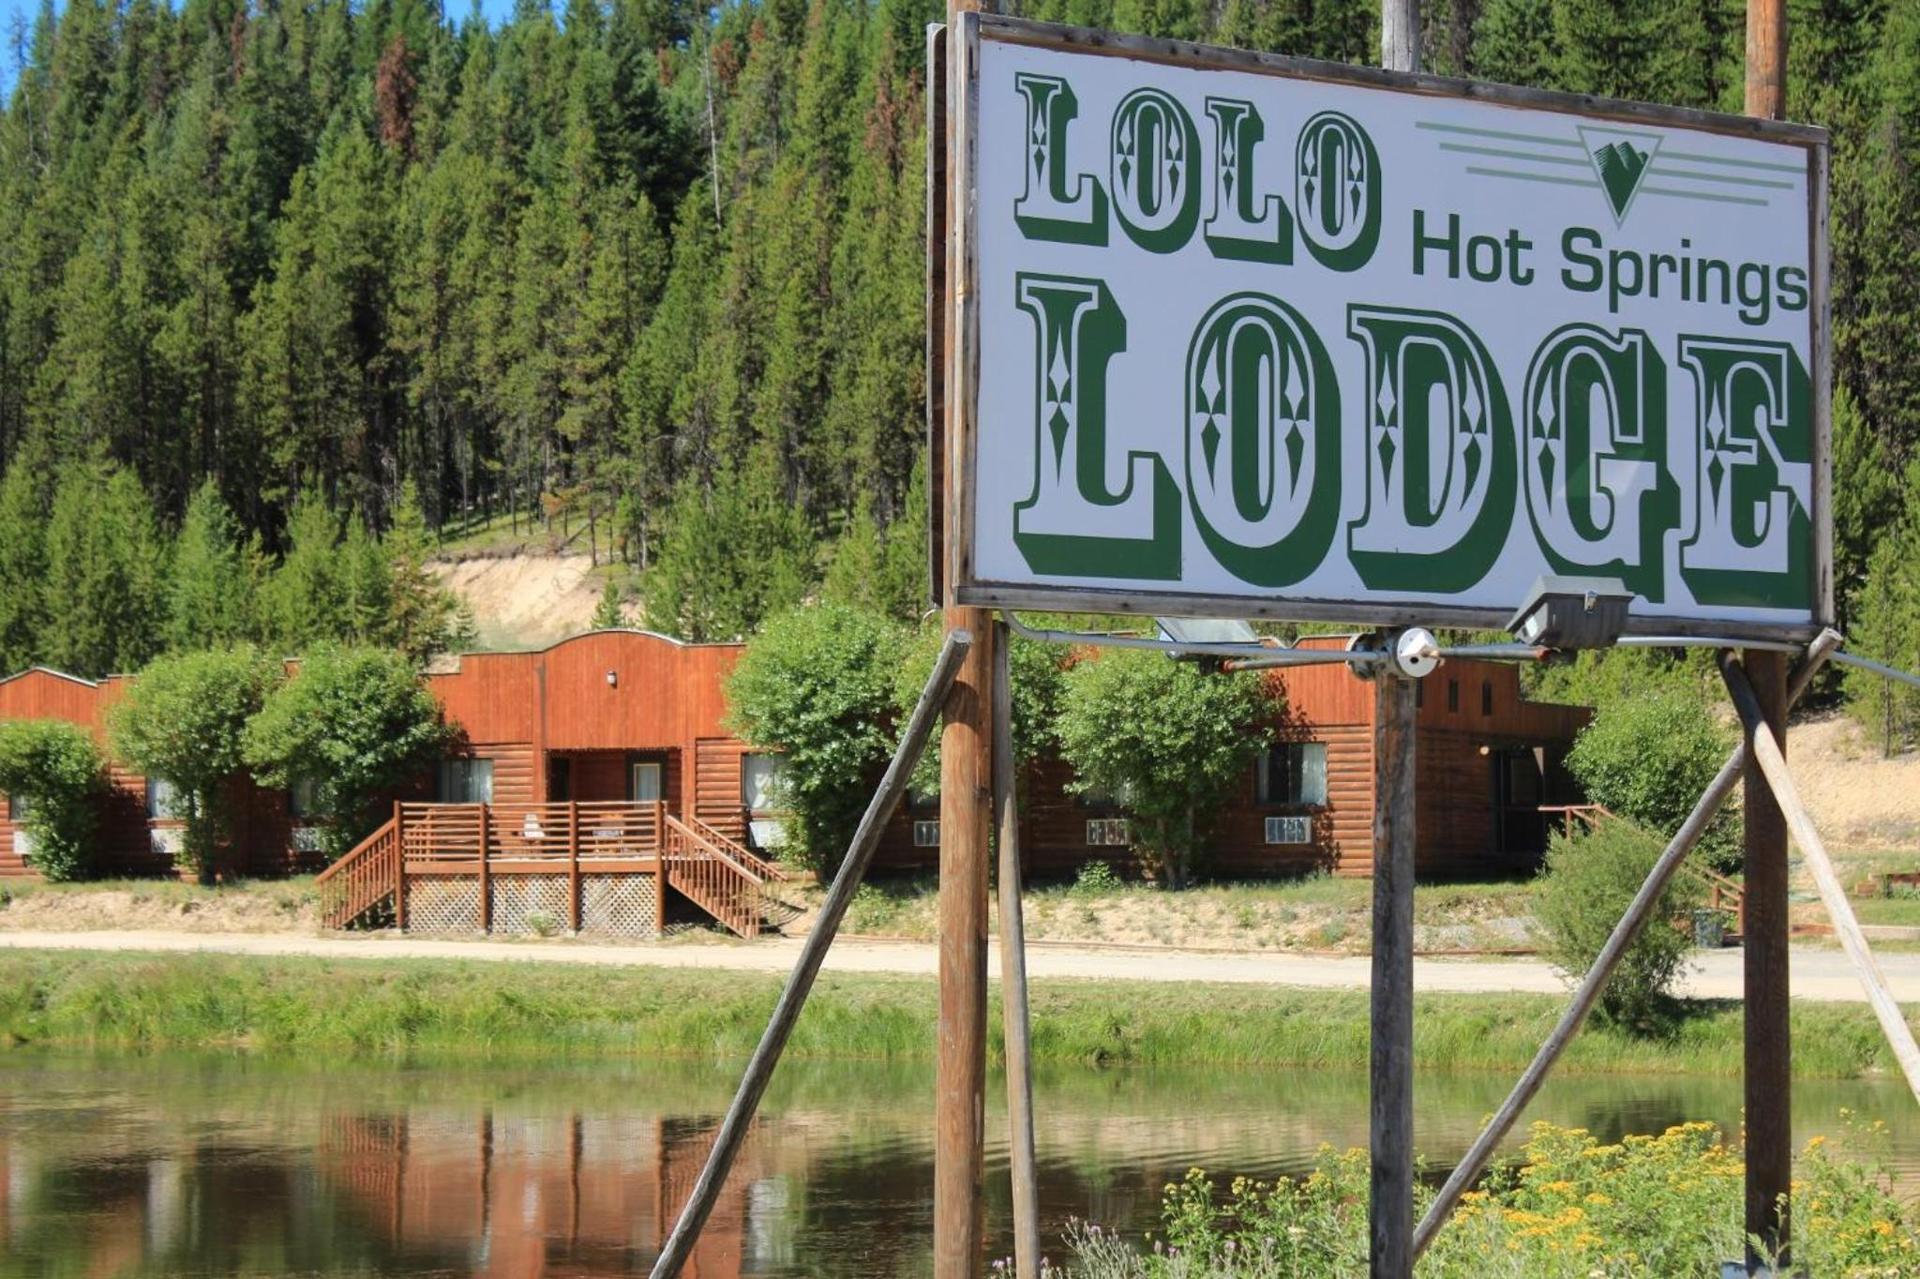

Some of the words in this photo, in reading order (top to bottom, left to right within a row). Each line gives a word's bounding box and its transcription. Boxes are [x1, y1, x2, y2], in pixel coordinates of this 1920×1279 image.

[1014, 71, 1382, 272] LOLO
[1412, 209, 1535, 286] Hot
[1560, 226, 1808, 326] Springs
[1013, 271, 1812, 608] LODGE
